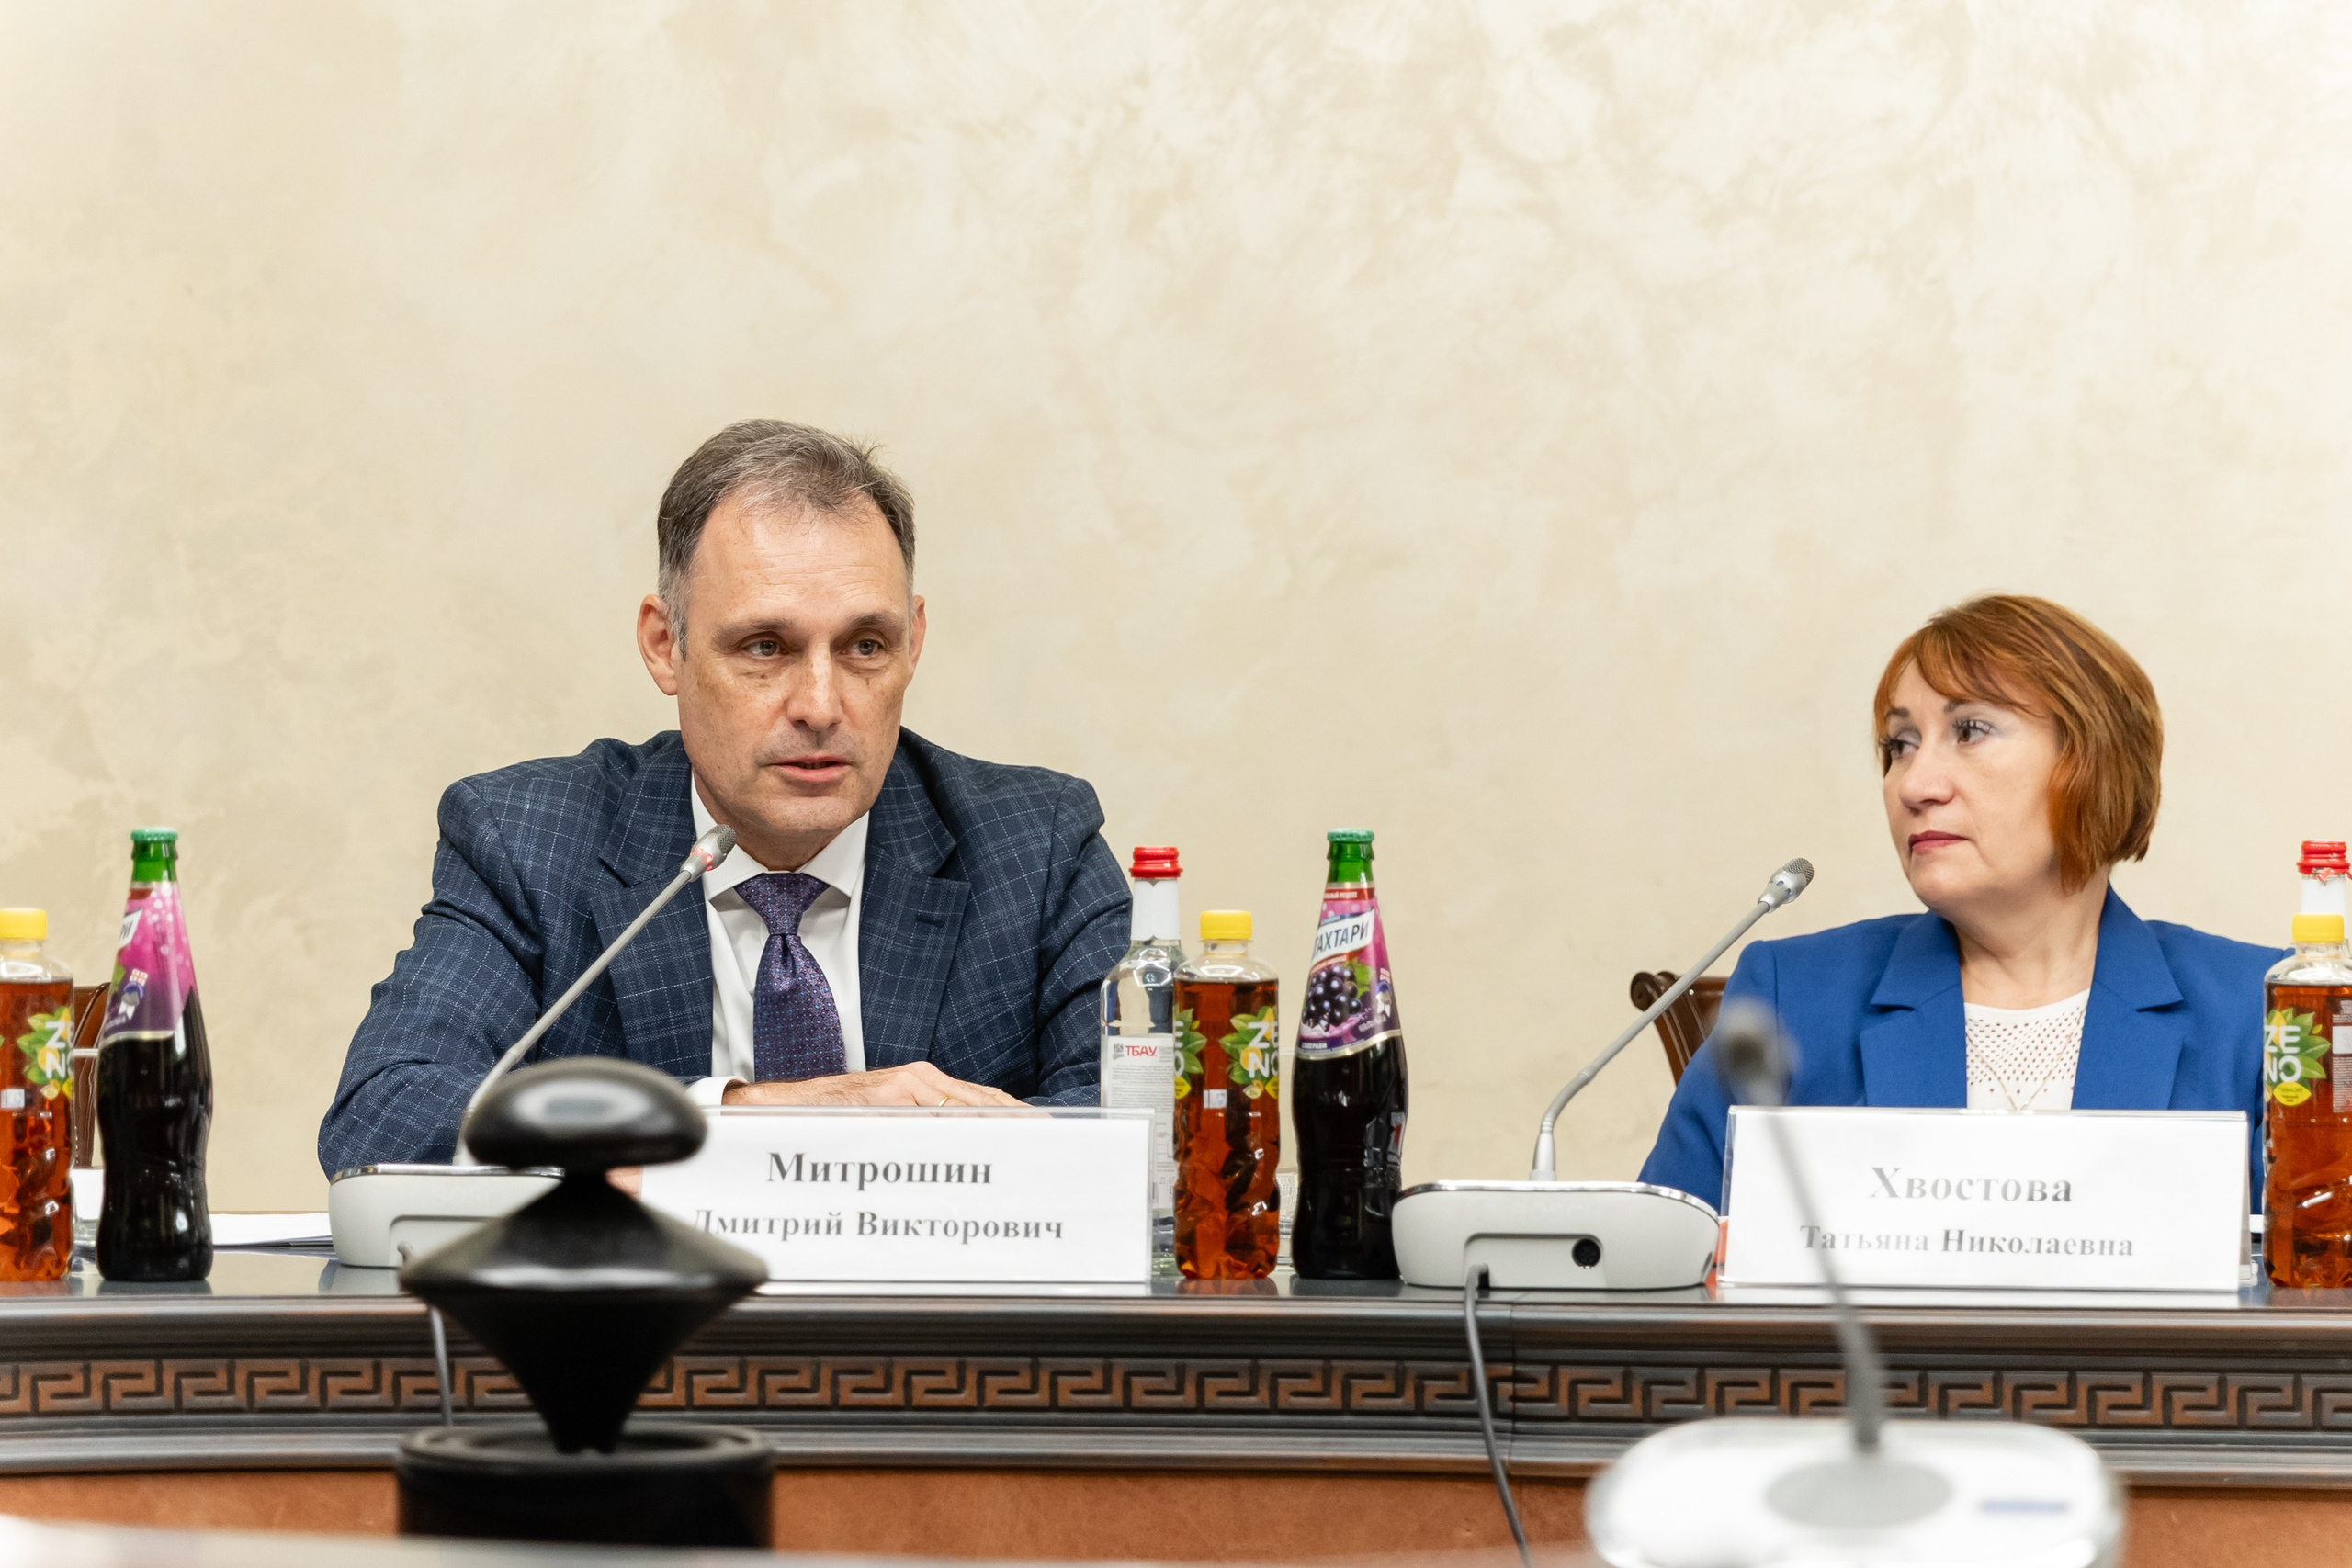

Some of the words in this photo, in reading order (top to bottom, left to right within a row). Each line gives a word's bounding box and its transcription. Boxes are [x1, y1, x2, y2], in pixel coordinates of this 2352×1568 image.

[1125, 1045, 1158, 1057] ТБАУ
[2264, 1024, 2301, 1054] ZE
[2263, 1055, 2302, 1083] NO
[766, 1151, 993, 1192] Митрошин
[1868, 1166, 2073, 1202] Хвостова
[694, 1208, 843, 1242] Дмитрий
[856, 1211, 1064, 1245] Викторович
[1799, 1224, 1928, 1251] Татьяна
[1941, 1228, 2133, 1257] Николаевна
